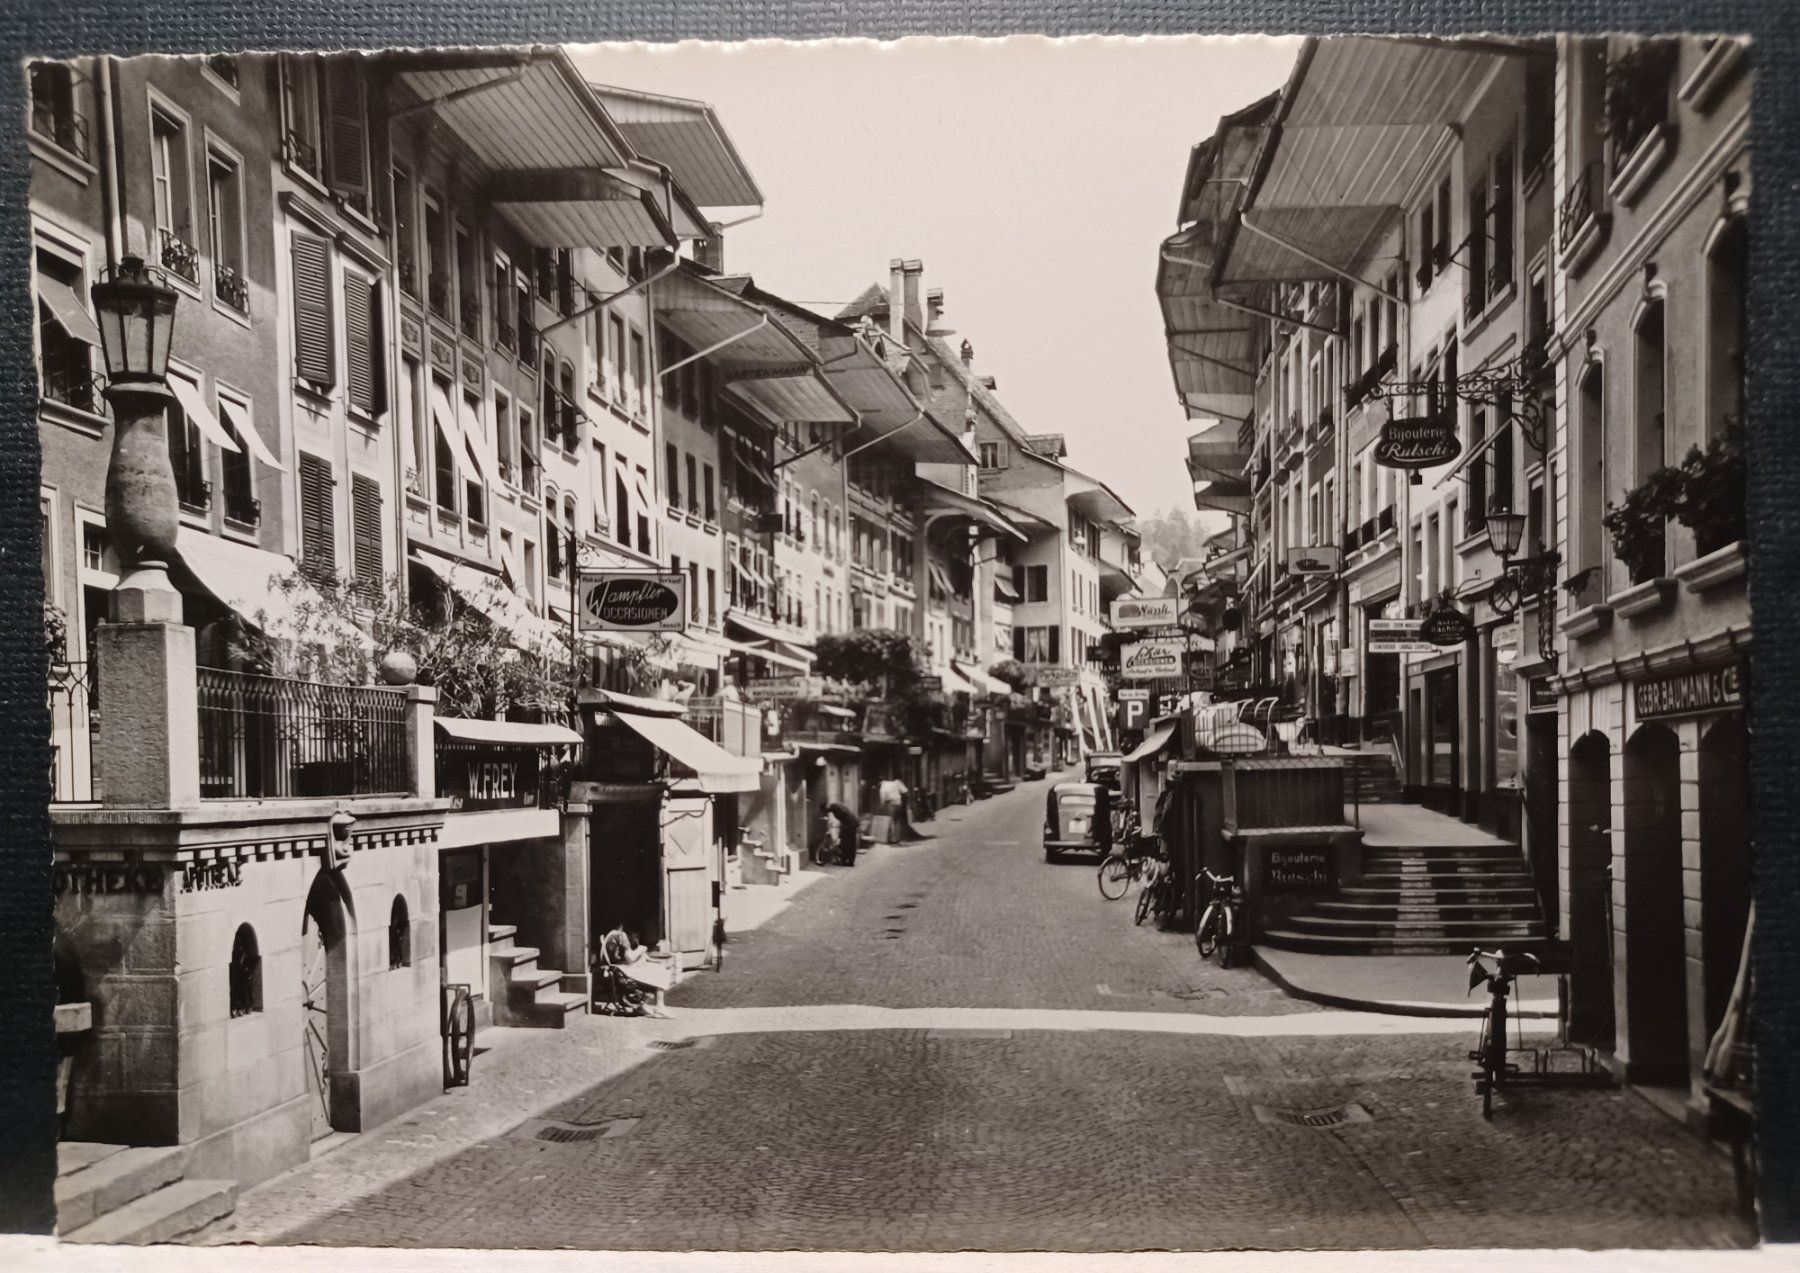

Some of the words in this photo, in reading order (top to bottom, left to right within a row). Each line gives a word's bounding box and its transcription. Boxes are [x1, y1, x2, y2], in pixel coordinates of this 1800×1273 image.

[1388, 426, 1447, 441] Bijouterie
[588, 580, 666, 618] Wampfler
[603, 606, 668, 620] OCCASIONEN
[1127, 700, 1144, 729] P
[1271, 852, 1326, 866] Bijouterie
